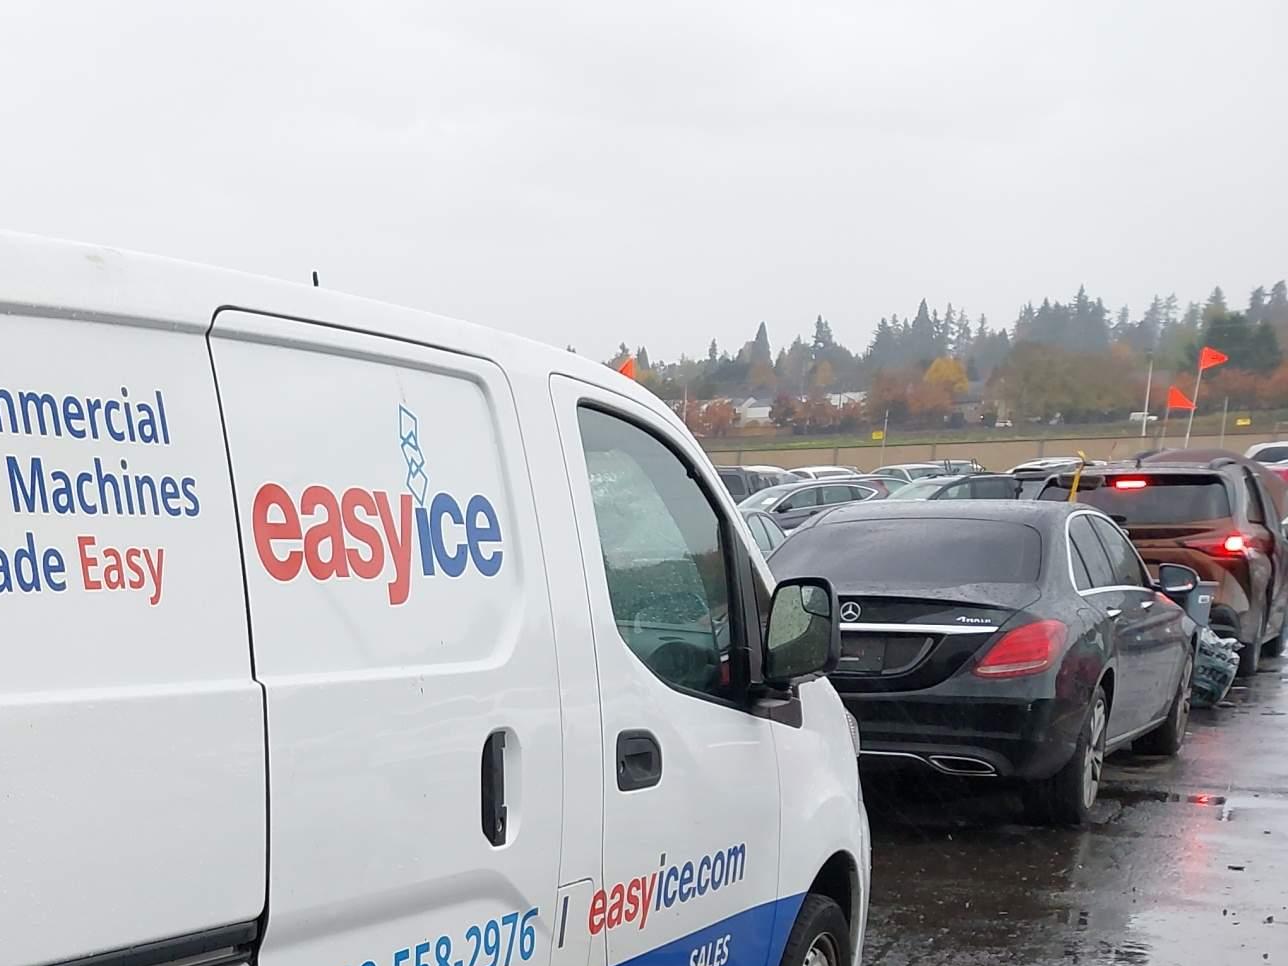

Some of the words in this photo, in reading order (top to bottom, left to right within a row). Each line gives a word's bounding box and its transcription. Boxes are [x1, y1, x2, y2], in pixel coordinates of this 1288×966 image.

[6, 456, 200, 517] Machines
[77, 536, 164, 606] Easy
[252, 483, 502, 605] easyice
[588, 843, 746, 935] easyice.com
